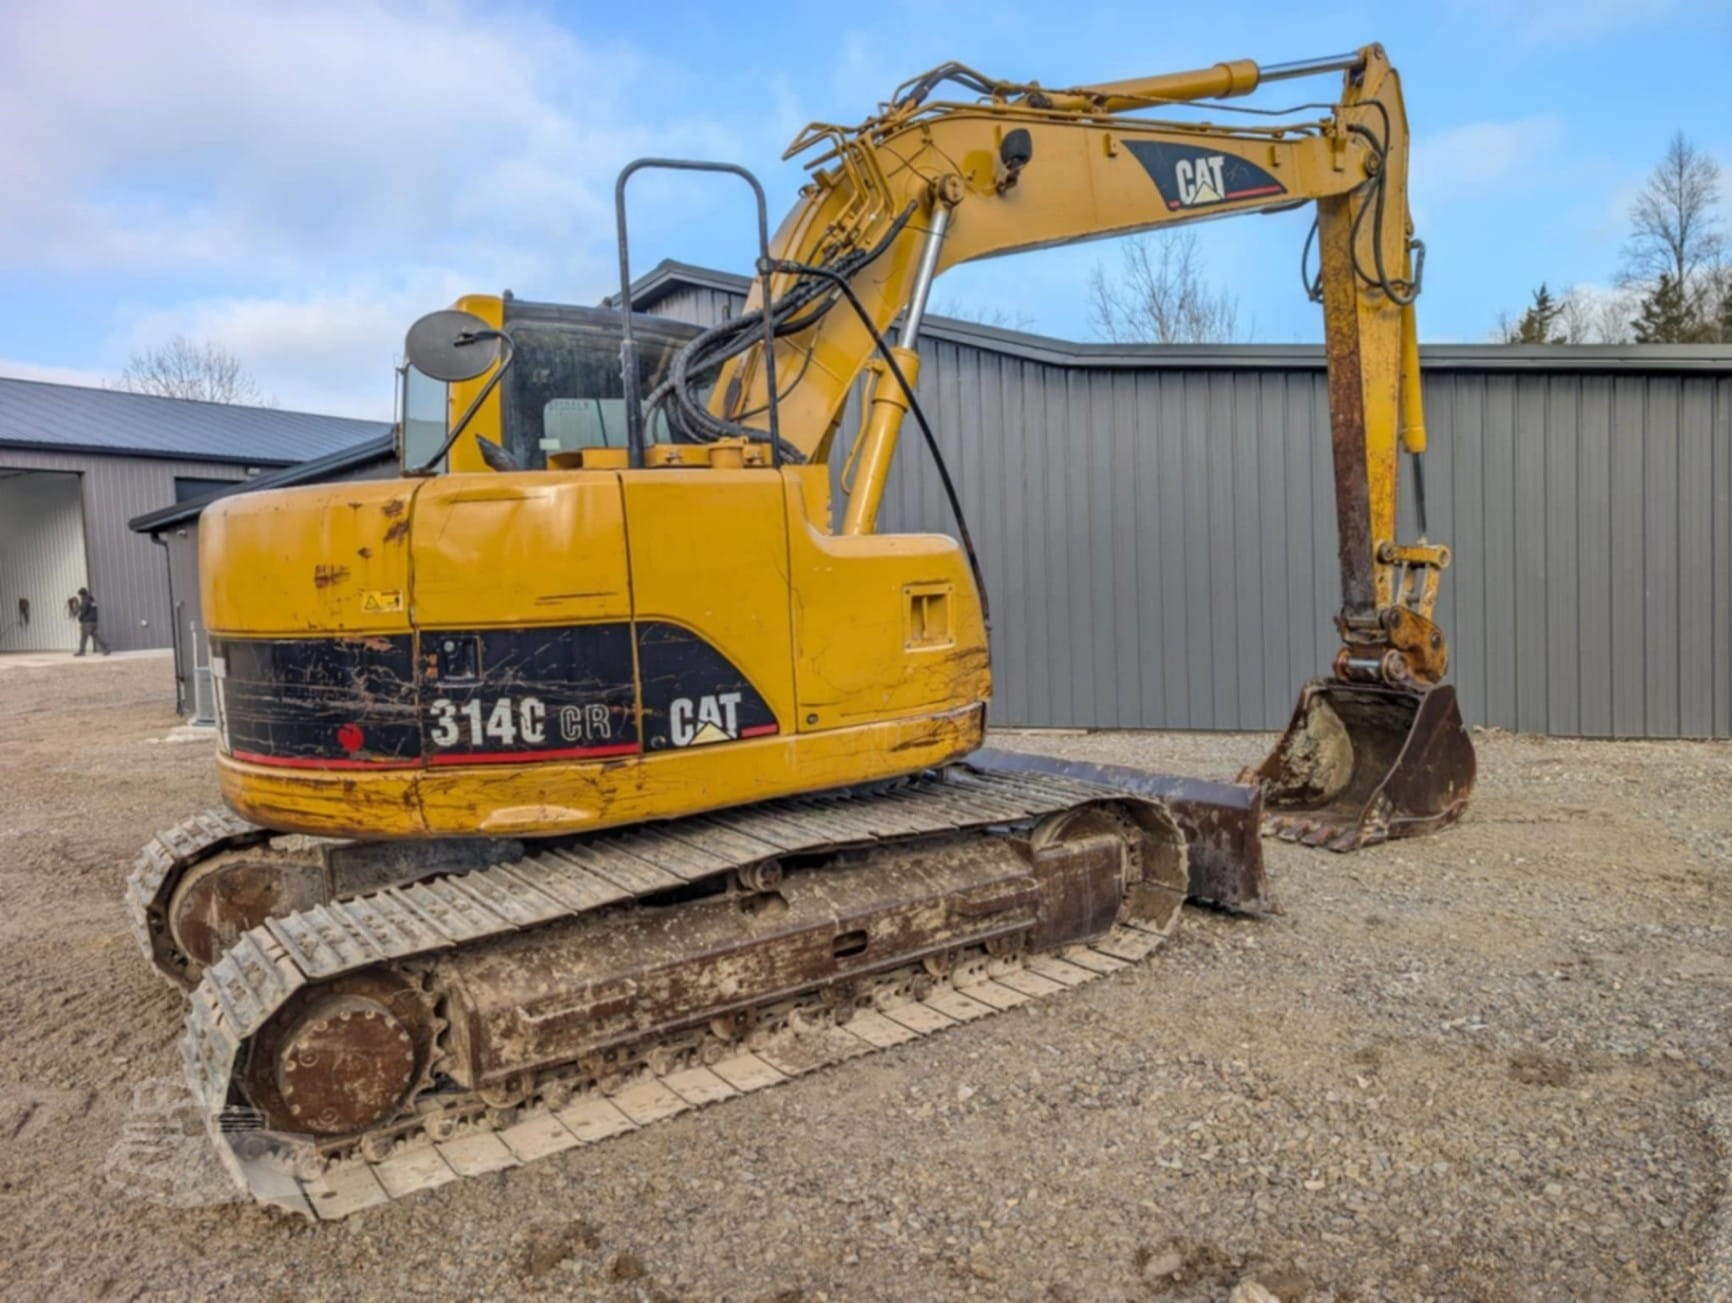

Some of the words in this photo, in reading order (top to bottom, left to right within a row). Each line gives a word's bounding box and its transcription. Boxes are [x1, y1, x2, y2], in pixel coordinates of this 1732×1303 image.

[1175, 156, 1225, 205] CAT
[429, 697, 546, 747] 314C
[560, 704, 611, 742] CR
[670, 692, 742, 747] CAT
